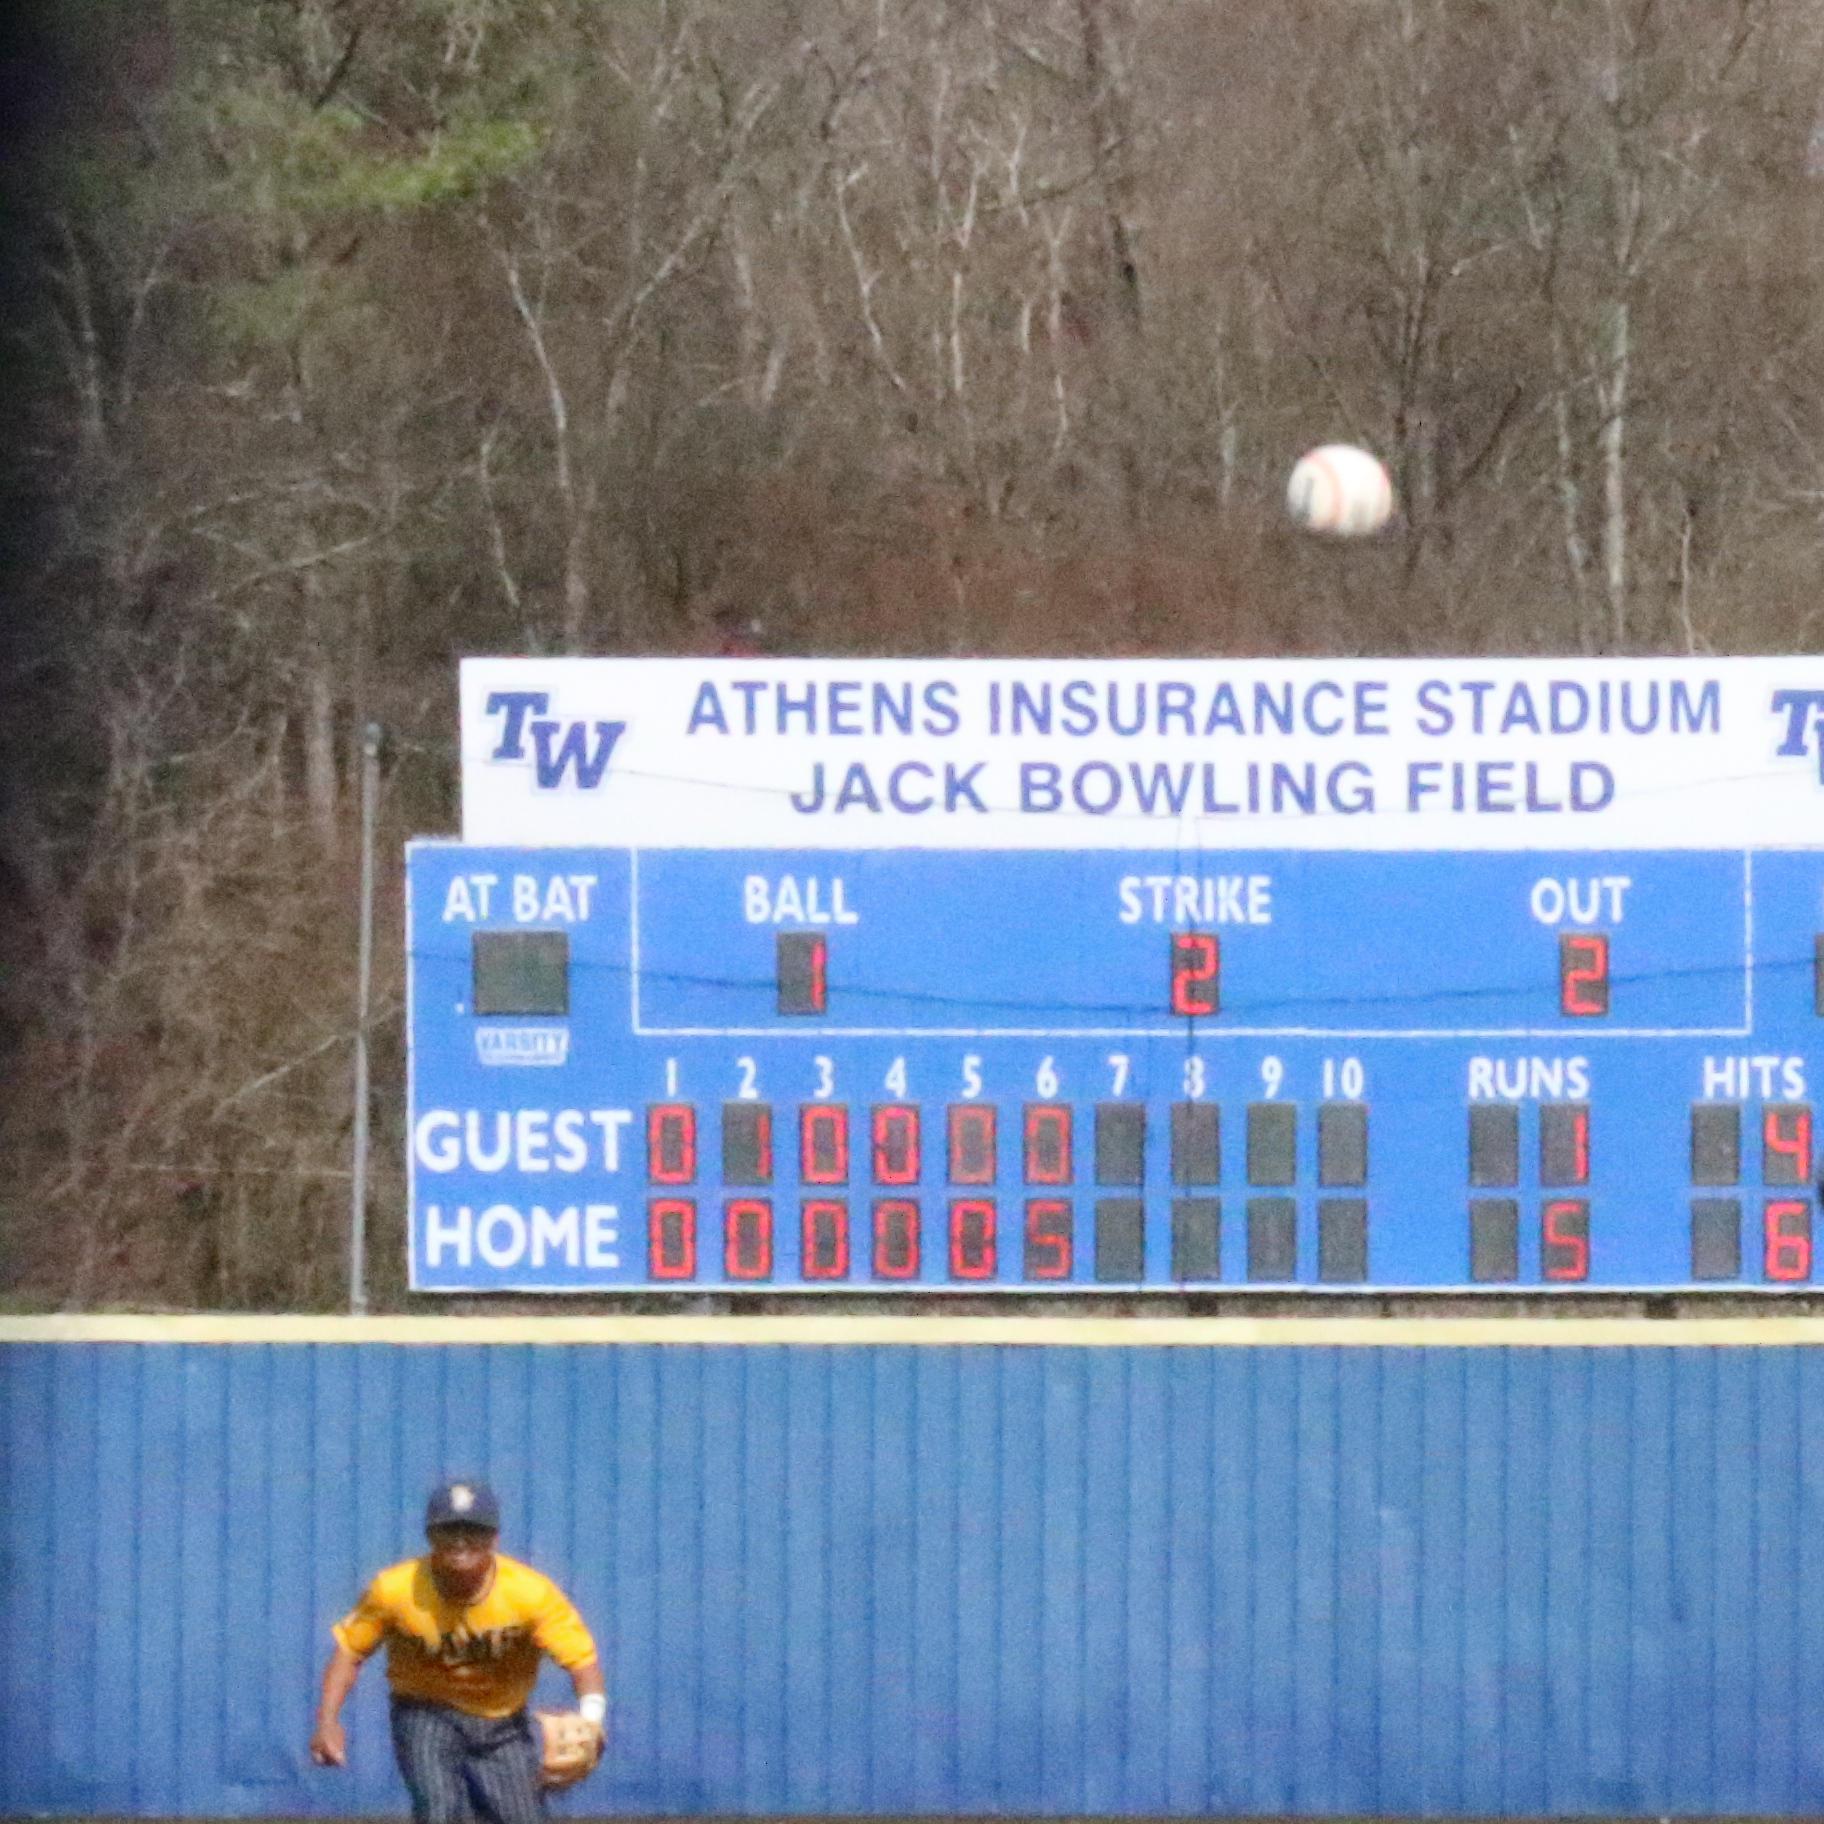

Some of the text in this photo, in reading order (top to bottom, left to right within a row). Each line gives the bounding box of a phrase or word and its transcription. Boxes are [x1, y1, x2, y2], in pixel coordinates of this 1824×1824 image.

[688, 680, 1720, 736] ATHENS INSURANCE STADIUM
[486, 692, 625, 789] TW
[791, 762, 1615, 814] JACK BOWLING FIELD
[443, 874, 597, 923] AT BAT
[744, 874, 859, 925] BALL
[1119, 875, 1271, 924] STRIKE
[1531, 876, 1631, 925] OUT
[1176, 935, 1218, 1014] 2
[1564, 937, 1607, 1015] 2
[666, 1058, 678, 1098] 1
[738, 1056, 759, 1098] 2
[814, 1056, 834, 1098] 3
[885, 1057, 907, 1098] 4
[962, 1055, 982, 1098] 5
[1036, 1056, 1059, 1098] 6
[1108, 1054, 1129, 1096] 7
[1261, 1056, 1283, 1098] 9
[1323, 1057, 1364, 1098] 10
[1468, 1057, 1589, 1098] RUNS
[1704, 1056, 1805, 1098] HITS
[414, 1109, 632, 1172] GUEST
[649, 1105, 695, 1184] 0
[804, 1107, 847, 1183] 0
[874, 1107, 919, 1185] 0
[1026, 1106, 1070, 1183] 0
[1765, 1113, 1810, 1179] 4
[426, 1205, 619, 1269] HOME
[650, 1200, 1071, 1279] 0 0 0 0 0 5
[1543, 1201, 1588, 1281] 5
[1765, 1202, 1812, 1281] 6
